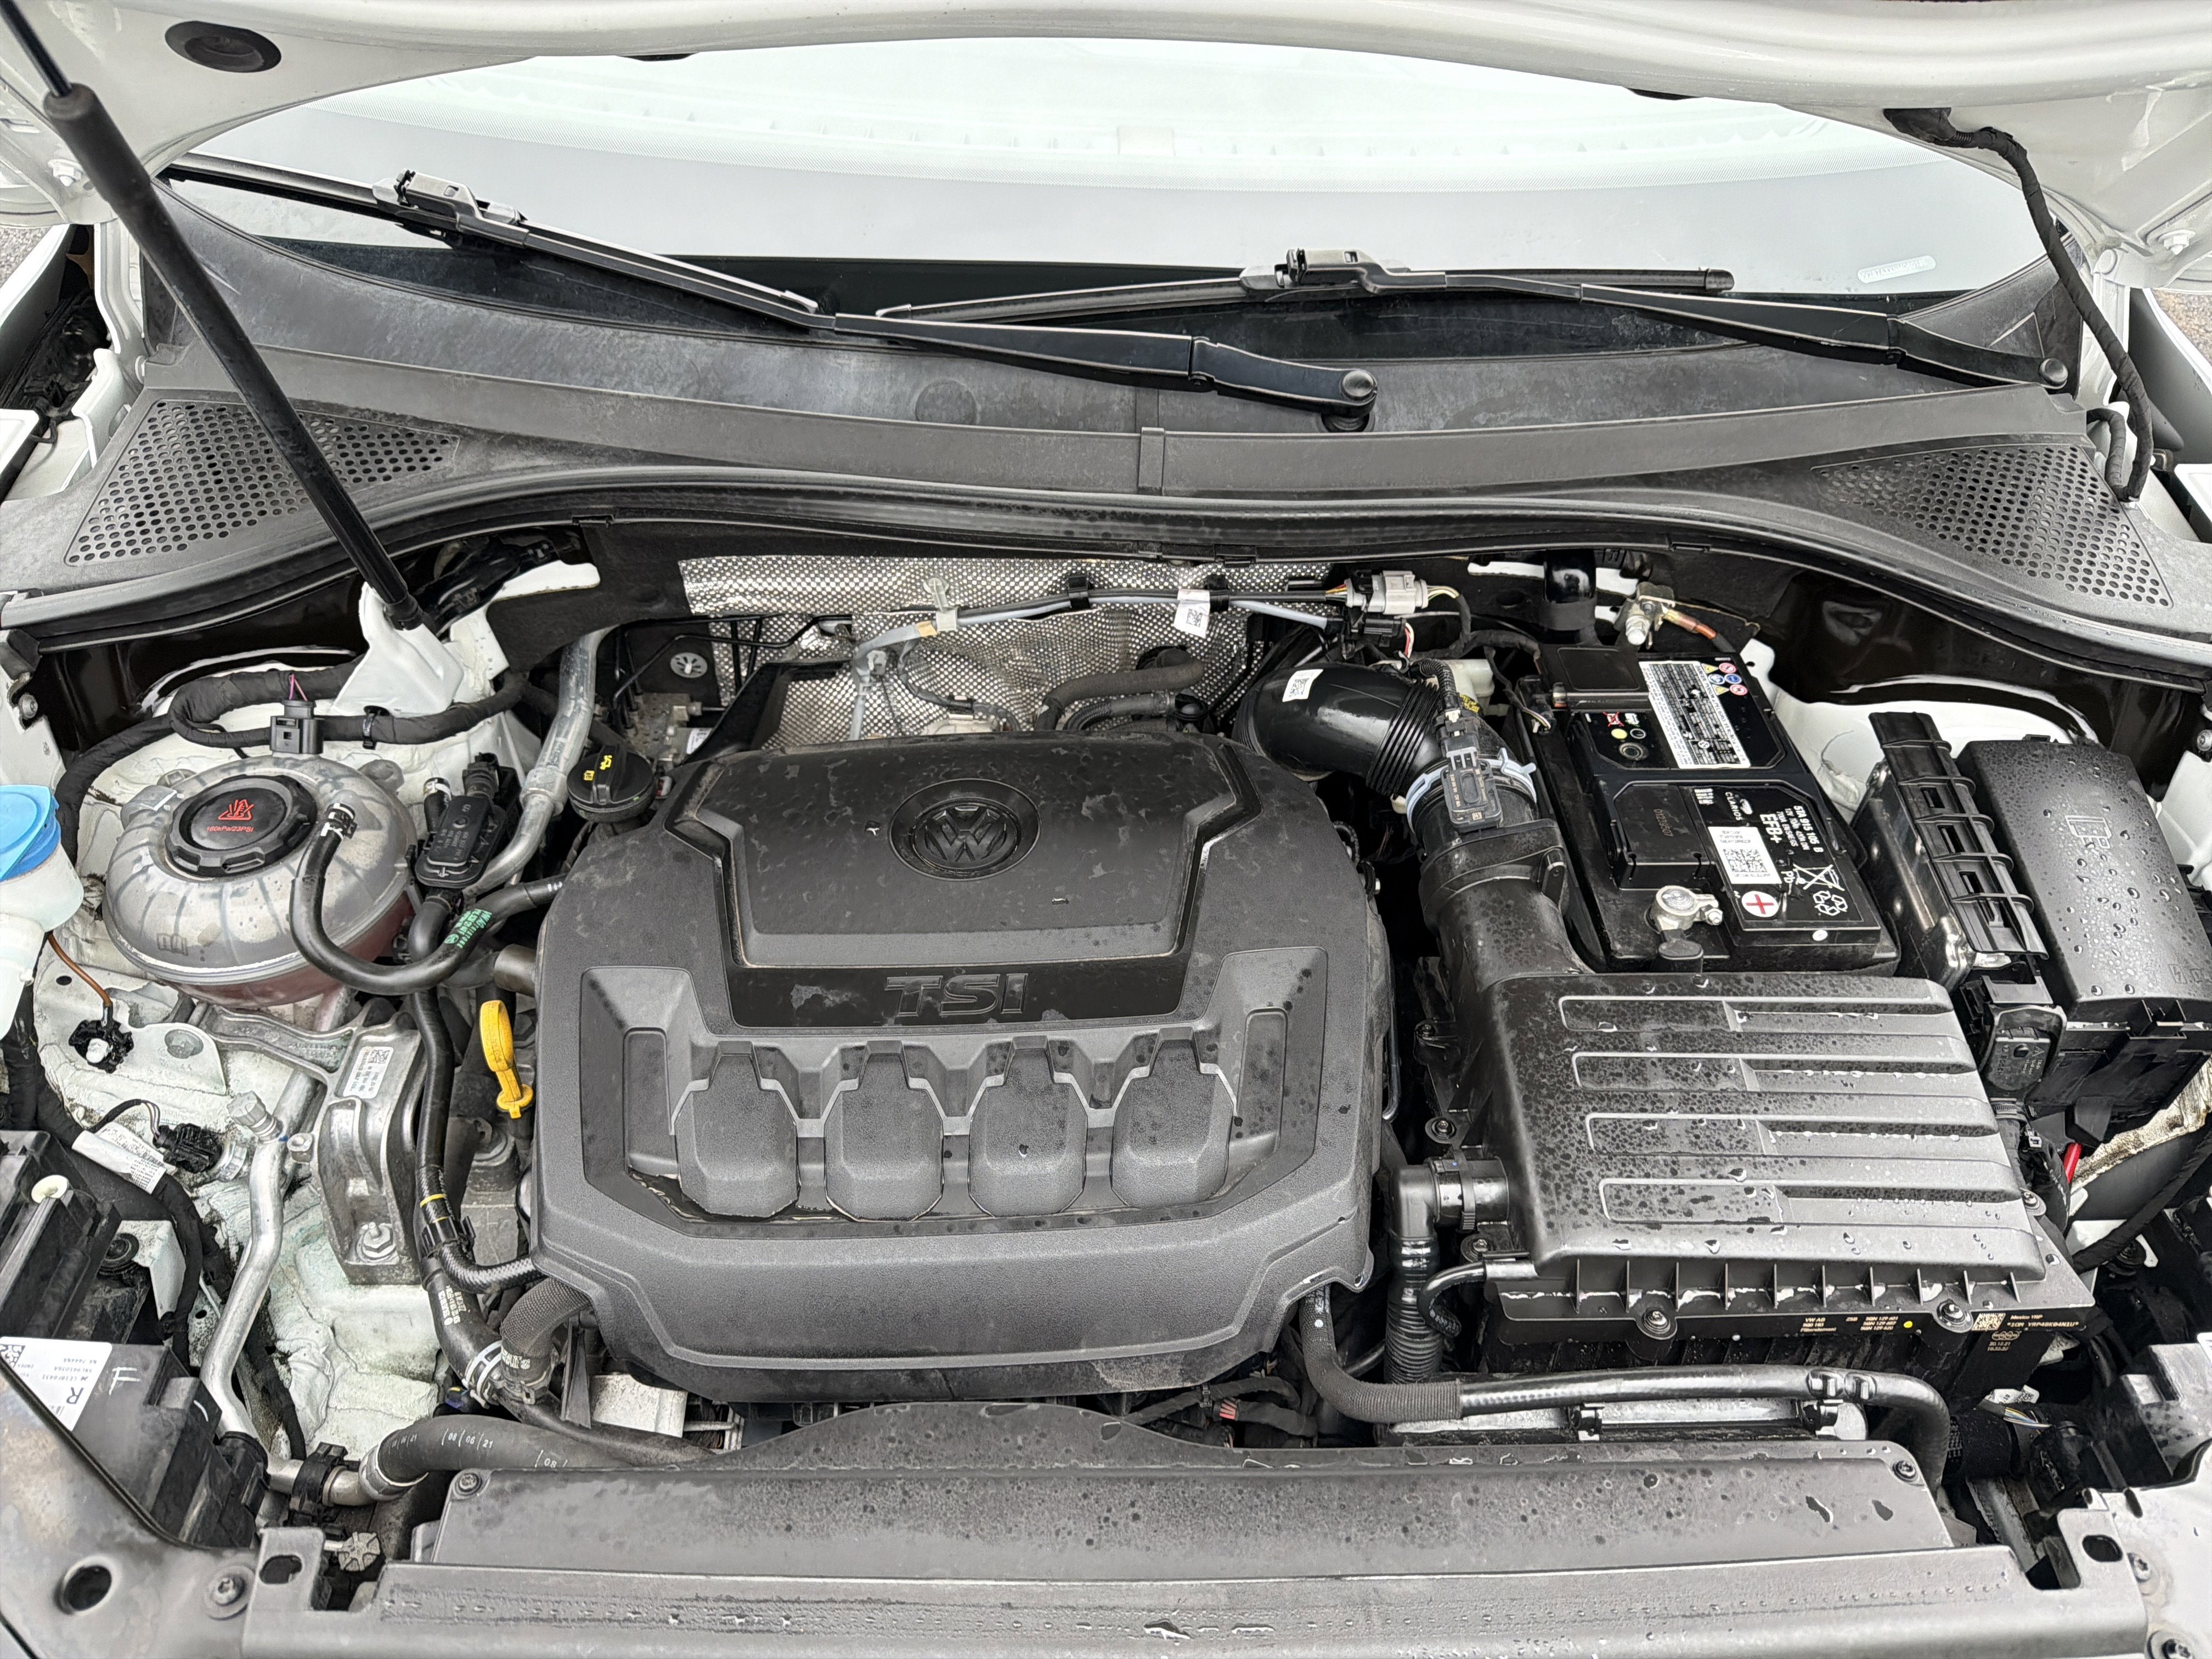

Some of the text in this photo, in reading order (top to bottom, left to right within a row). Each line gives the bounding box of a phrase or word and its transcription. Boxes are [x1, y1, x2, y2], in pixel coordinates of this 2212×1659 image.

[1725, 792, 1743, 821] CLARIOS
[1760, 814, 1782, 843] EFB+
[1800, 818, 1813, 831] 915
[1781, 870, 1795, 883] Pb
[884, 973, 1029, 1018] TSI
[66, 1386, 84, 1404] R
